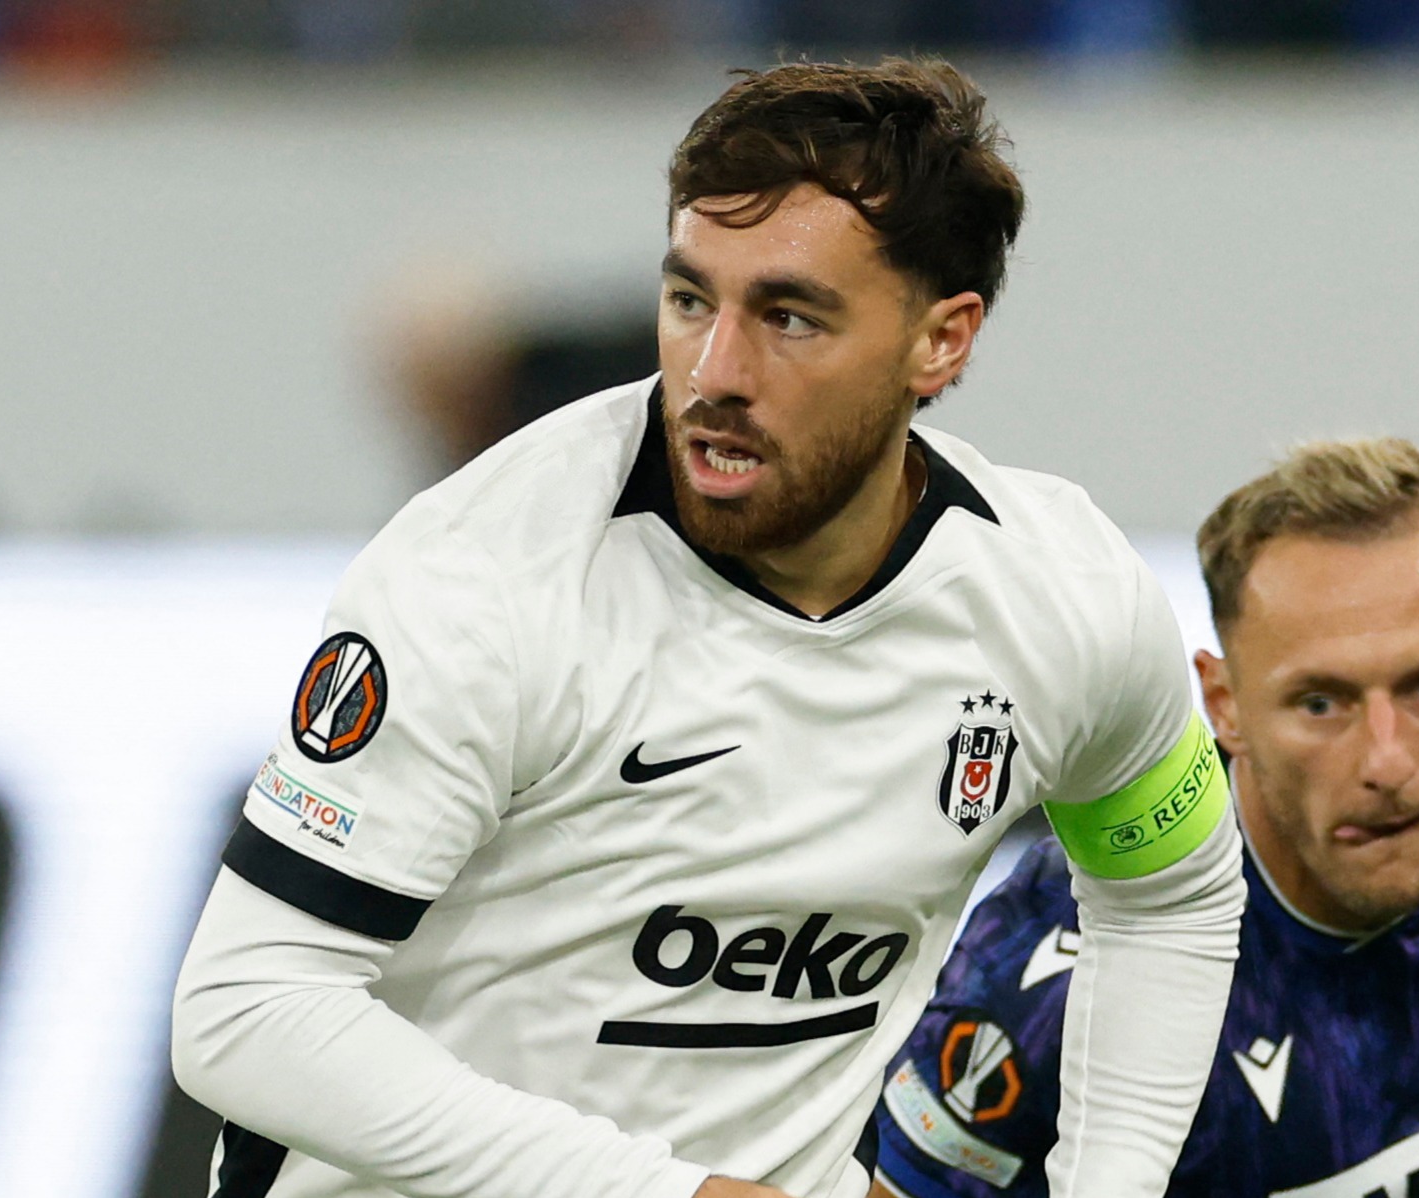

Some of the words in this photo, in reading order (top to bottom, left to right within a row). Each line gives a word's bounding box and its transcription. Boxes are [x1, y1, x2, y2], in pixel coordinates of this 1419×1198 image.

[959, 733, 1006, 756] BJK
[1153, 730, 1214, 830] RESPEC
[953, 804, 992, 819] 1903
[298, 819, 312, 831] for
[631, 904, 910, 1000] beko
